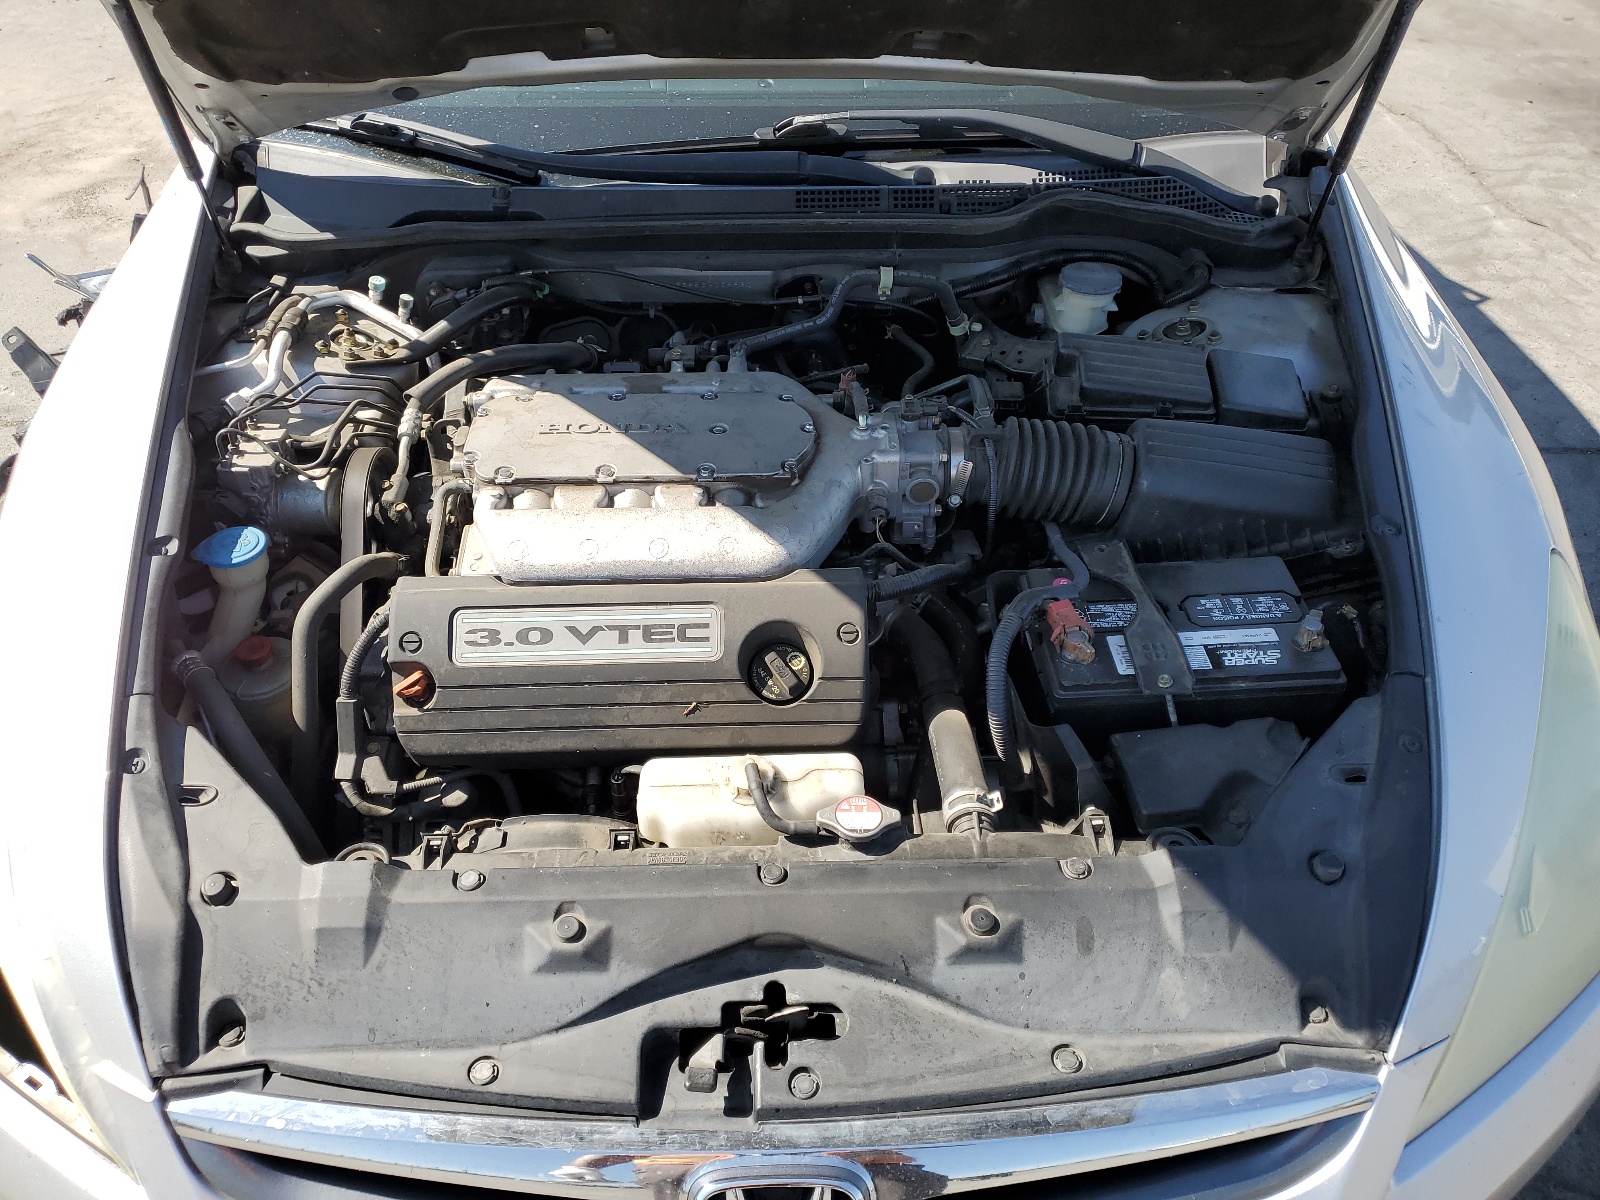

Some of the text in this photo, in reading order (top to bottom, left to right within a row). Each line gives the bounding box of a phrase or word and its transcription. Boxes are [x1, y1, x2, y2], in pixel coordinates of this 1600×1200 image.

[538, 421, 690, 435] HONDA
[463, 622, 712, 648] 3.0 VTEC
[1222, 649, 1281, 660] START
[1224, 657, 1278, 666] SUPER
